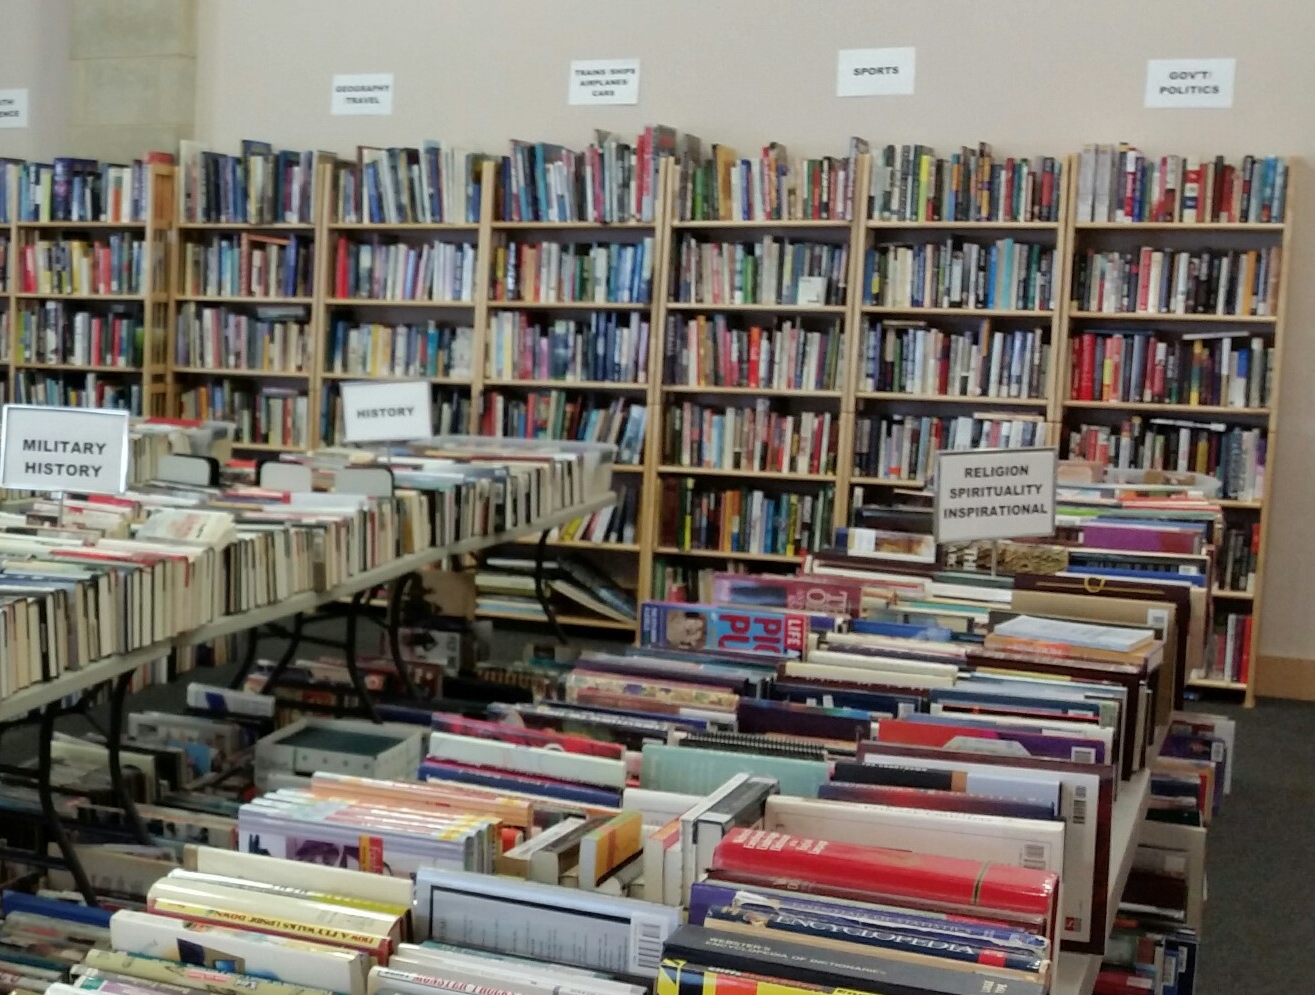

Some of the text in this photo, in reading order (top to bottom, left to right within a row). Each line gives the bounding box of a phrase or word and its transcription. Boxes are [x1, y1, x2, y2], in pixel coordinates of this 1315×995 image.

[853, 66, 900, 76] SPORTS
[334, 85, 389, 93] GEOGRAPHY
[1159, 85, 1219, 95] POLITICS
[356, 406, 414, 419] HISTORY
[22, 439, 107, 455] MILITARY
[24, 461, 103, 478] HISTORY
[964, 465, 1030, 479] RELIGION
[949, 484, 1043, 500] SPIRITUALITY
[943, 503, 1048, 520] INSPIRATIONAL
[787, 619, 803, 647] LIFE
[282, 922, 316, 934] WALKS
[775, 914, 975, 955] ENCYCLOPEDIA
